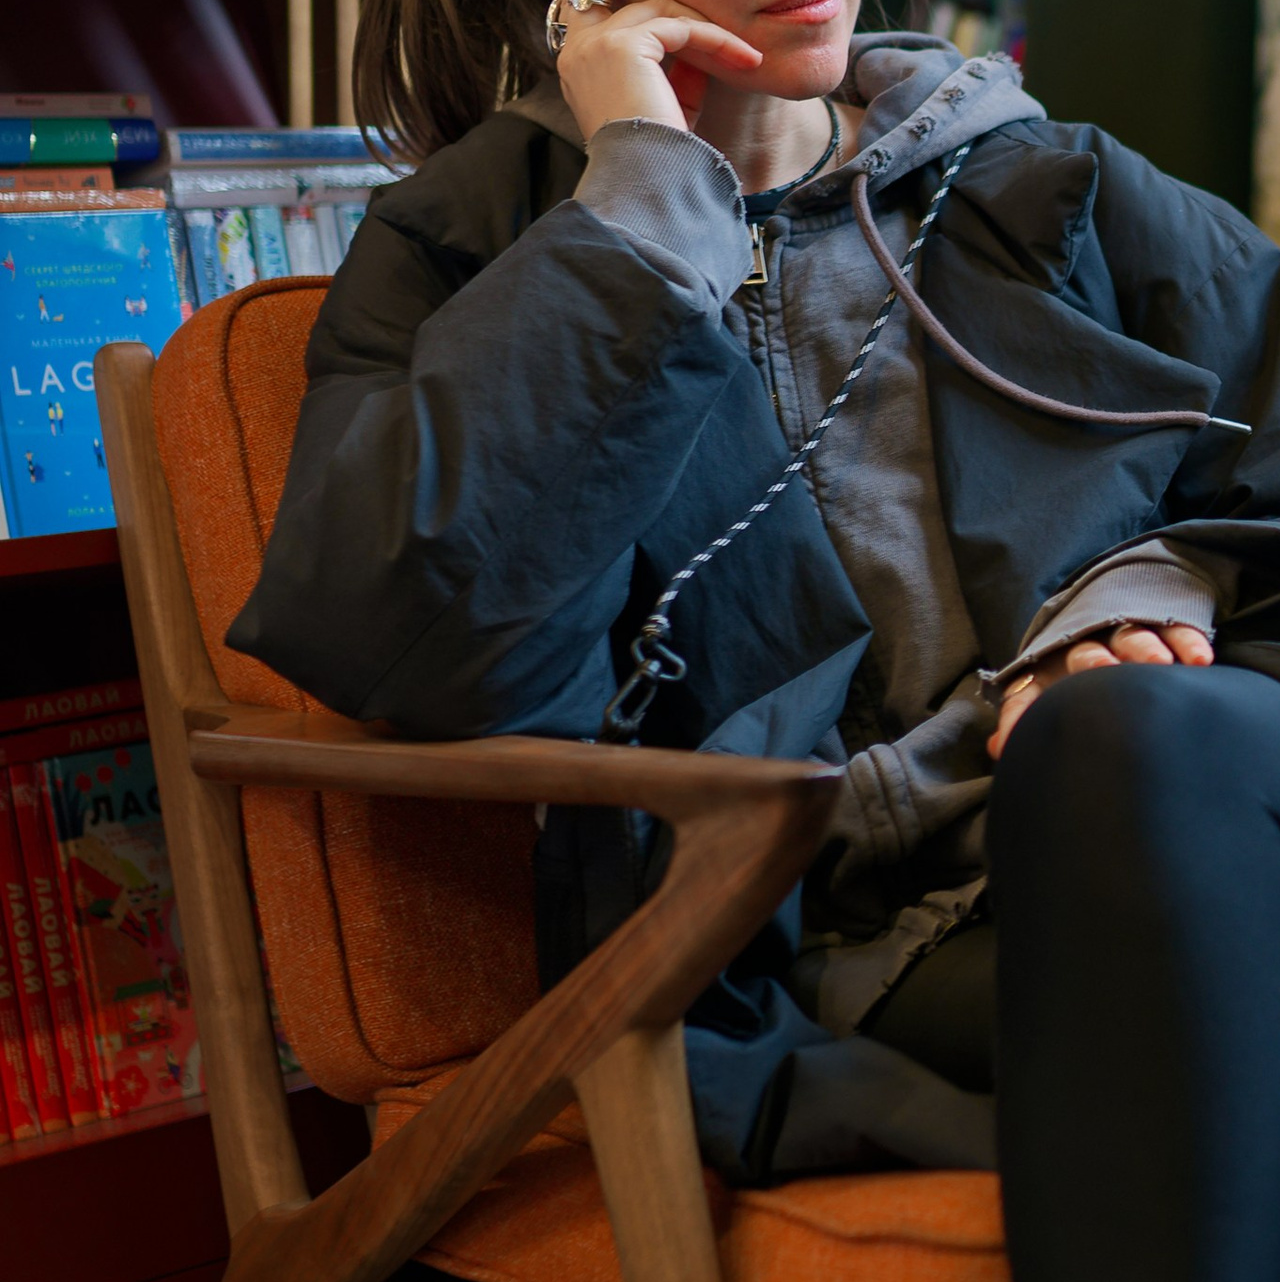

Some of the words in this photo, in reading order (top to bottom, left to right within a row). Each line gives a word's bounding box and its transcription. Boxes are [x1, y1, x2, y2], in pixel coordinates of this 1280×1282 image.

[24, 265, 58, 277] СЕКРЕТ
[31, 335, 101, 349] МАЛЕНЬКАЯ
[25, 686, 121, 721] ЛАОВАЙ
[6, 881, 43, 994] ЛАОВАЙ
[34, 877, 69, 988] ЛАОВАЙ
